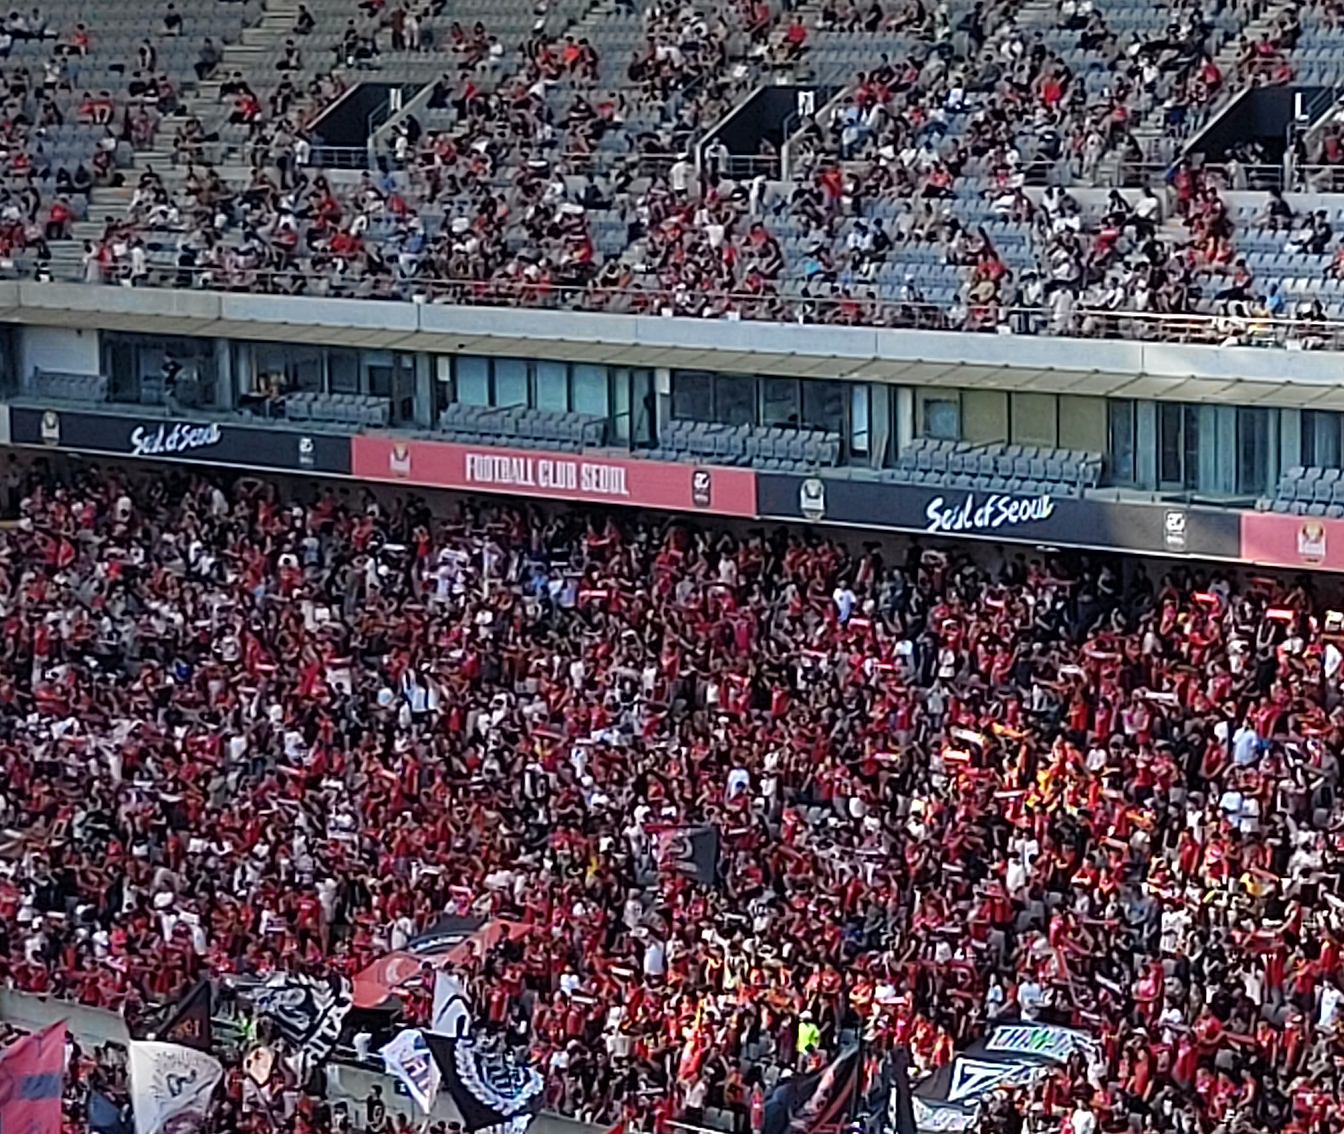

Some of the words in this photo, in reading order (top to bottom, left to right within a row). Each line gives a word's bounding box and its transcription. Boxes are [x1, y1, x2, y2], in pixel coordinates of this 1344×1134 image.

[1295, 92, 1309, 120] L
[465, 452, 536, 488] FOOTBALL
[538, 460, 577, 491] CLUB
[581, 464, 630, 496] SEOUL
[993, 493, 1055, 526] Seoul
